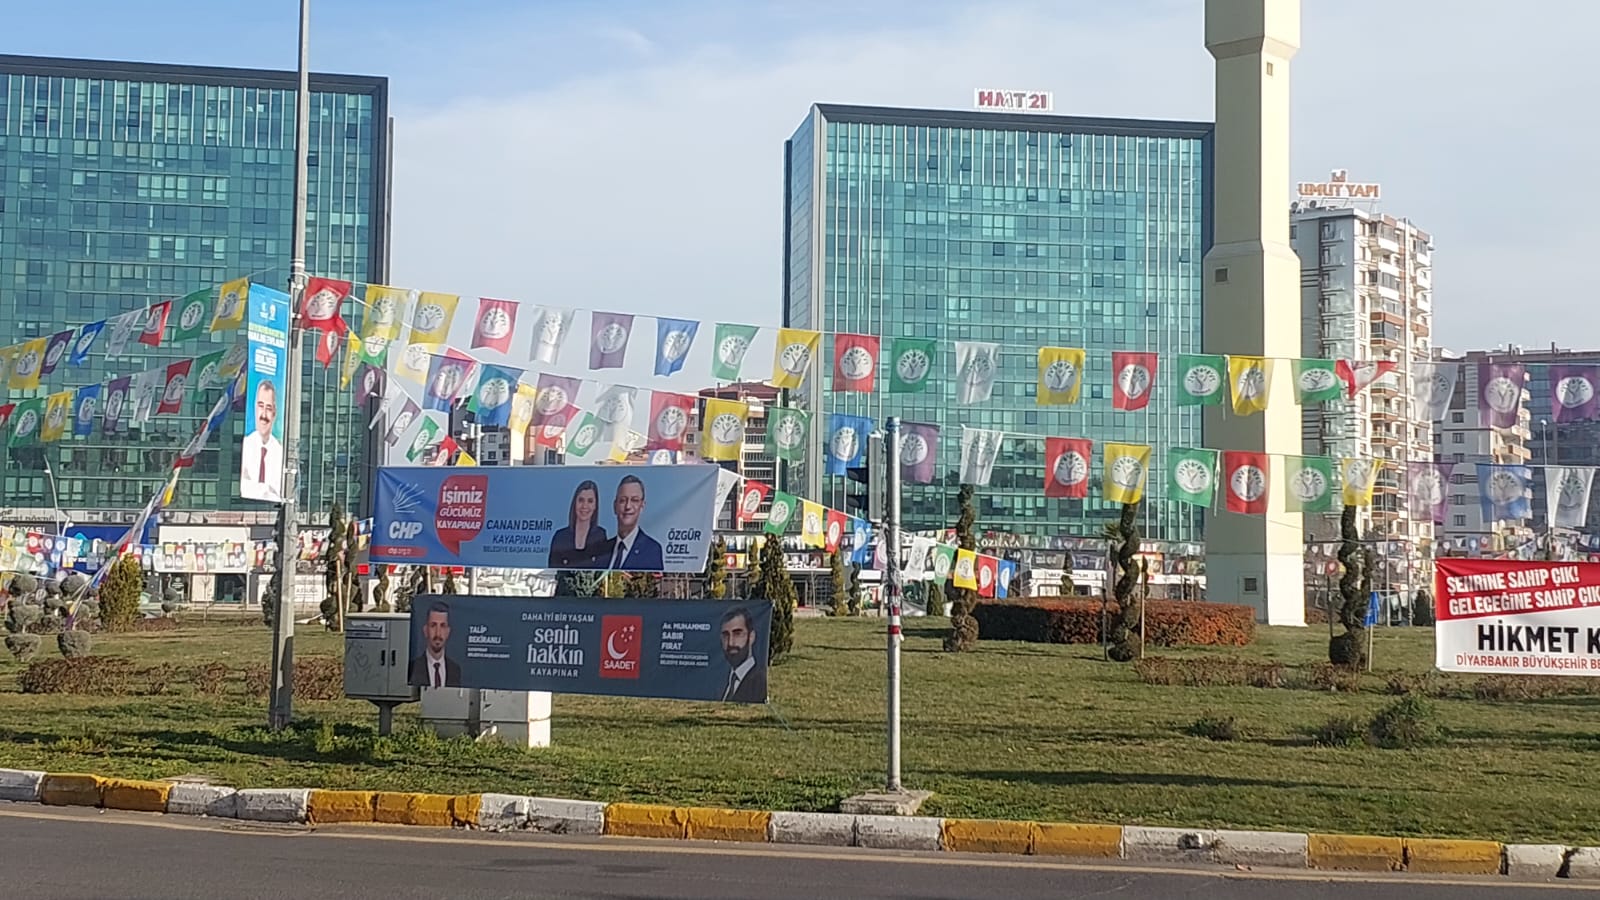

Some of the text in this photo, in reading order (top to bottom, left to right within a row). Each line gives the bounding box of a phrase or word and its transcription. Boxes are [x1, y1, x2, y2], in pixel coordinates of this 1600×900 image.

[978, 91, 1047, 108] HMT 21
[1298, 182, 1379, 198] UMUT YAPI
[442, 486, 484, 504] işimiz
[439, 506, 482, 517] GÜCÜMÜZ
[389, 520, 423, 540] CHP
[436, 520, 481, 529] KAYAPINAR
[487, 518, 553, 531] CANAN DEMİR
[492, 534, 541, 545] KAYAPINAR
[668, 528, 701, 540] ÖZGÜR
[666, 542, 689, 554] ÖZEL
[1551, 566, 1579, 587] ÇIK!
[522, 612, 594, 623] DAHA İYİ BİR YAŞAM
[469, 625, 487, 633] TALİP
[673, 623, 710, 631] MUHAMMED
[534, 624, 578, 644] senin
[662, 632, 683, 640] SABIR
[1478, 619, 1578, 653] HİKMET
[661, 642, 682, 650] FIRAT
[527, 644, 583, 665] hakkın
[1456, 652, 1520, 667] DİYARBAKIR
[1522, 655, 1588, 669] BÜYÜKŞEHİR
[604, 660, 636, 670] SAADET
[531, 668, 578, 677] KAYAPINAR
